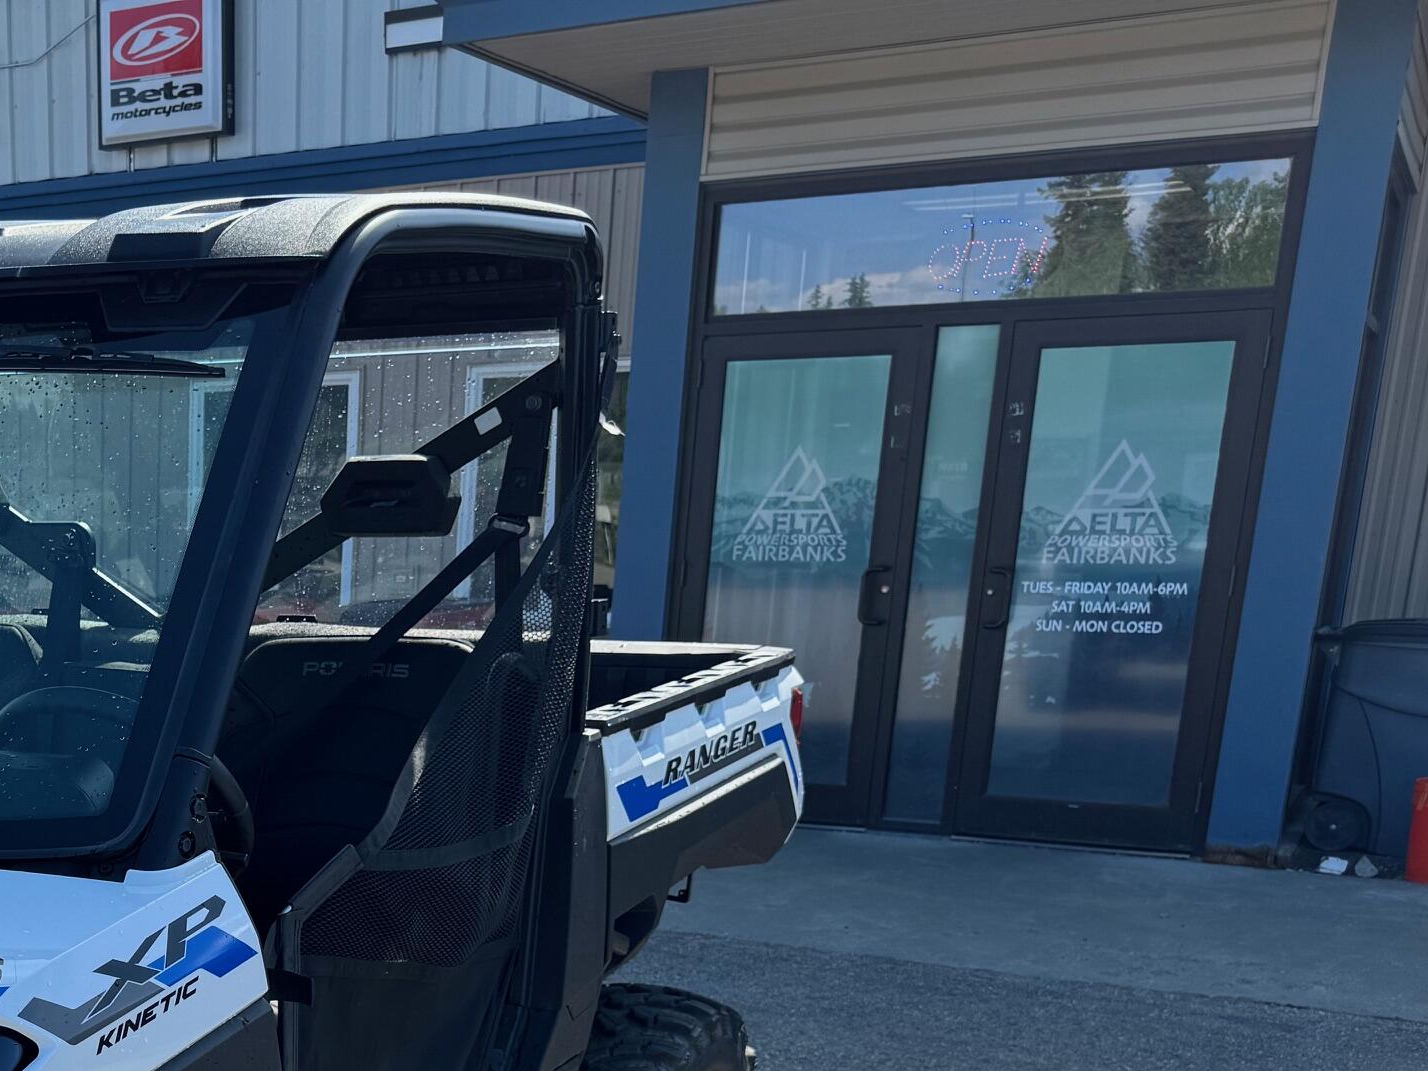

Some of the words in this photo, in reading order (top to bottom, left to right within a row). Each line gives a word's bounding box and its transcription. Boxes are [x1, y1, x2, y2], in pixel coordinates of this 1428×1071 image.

[110, 81, 203, 107] Beta
[110, 101, 203, 122] motorcycles
[928, 236, 1048, 280] OPEN
[734, 534, 847, 546] POWERSPORTS
[1045, 534, 1178, 547] POWERSPORTS
[732, 545, 847, 561] FAIRBANKS
[1041, 547, 1177, 564] FAIRBANKS
[1021, 581, 1053, 594] TUES
[1064, 582, 1112, 594] FRIDAY
[1115, 582, 1188, 595] 10AM-6PM
[1052, 600, 1075, 613] SAT
[1079, 601, 1151, 614] 10AM-4PM
[1036, 620, 1063, 632] SUN
[1073, 620, 1108, 632] MON
[1111, 621, 1163, 634] CLOSED
[661, 720, 757, 787] RANGER
[81, 894, 227, 1024] XP
[96, 975, 200, 1056] KINETIC
